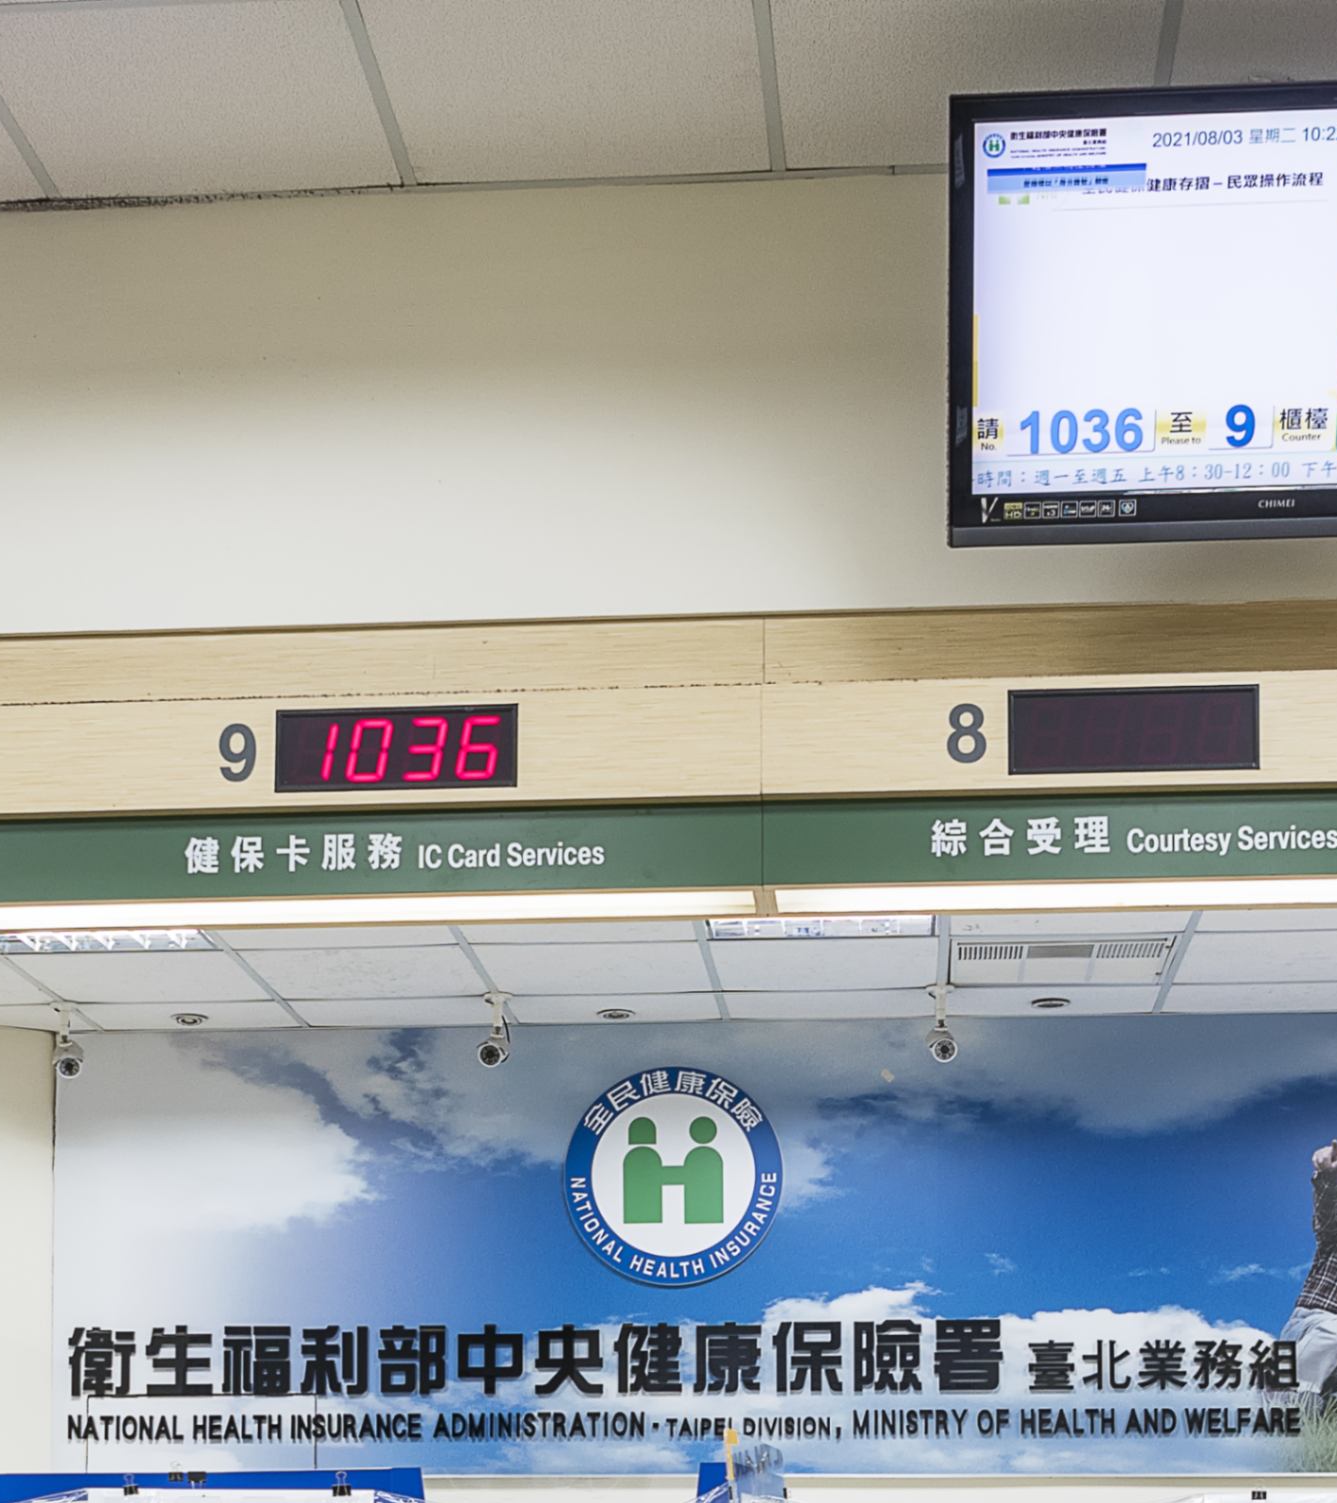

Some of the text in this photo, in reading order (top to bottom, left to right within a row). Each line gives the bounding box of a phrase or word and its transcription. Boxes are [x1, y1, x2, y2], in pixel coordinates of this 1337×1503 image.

[1152, 129, 1243, 148] 2021/08/03
[1249, 127, 1296, 144] 星期二
[977, 418, 999, 440] 請
[1019, 408, 1144, 455] 1036
[1169, 411, 1194, 434] 至
[1225, 404, 1256, 448] 9
[1161, 436, 1186, 446] Please
[1188, 436, 1201, 445] to
[1281, 432, 1322, 443] Counter
[1258, 498, 1296, 510] CHIMEI
[218, 723, 257, 783] 9
[320, 714, 502, 783] 1036
[946, 702, 987, 764] 8
[184, 833, 605, 875] 健保卡服務 IC Card Services
[930, 815, 1111, 858] 綜合受理
[1125, 827, 1231, 858] Courtesy
[583, 1070, 764, 1136] 全民健康保險
[570, 1172, 777, 1279] NATIONAL HEALTH INSURANCE
[67, 1318, 1301, 1397] 衛生福利部中央健康保險署 臺北業務組
[66, 1414, 185, 1442] NATIONAL
[192, 1413, 282, 1441] HEALTH
[290, 1412, 422, 1440] INSURANCE
[433, 1410, 646, 1439] ADMINISTRATION
[852, 1408, 968, 1437] MINISTRY
[976, 1408, 1010, 1437] OF
[1019, 1408, 1115, 1437] HEALTH
[1124, 1408, 1180, 1437] AND
[1185, 1407, 1301, 1437] WELFARE
